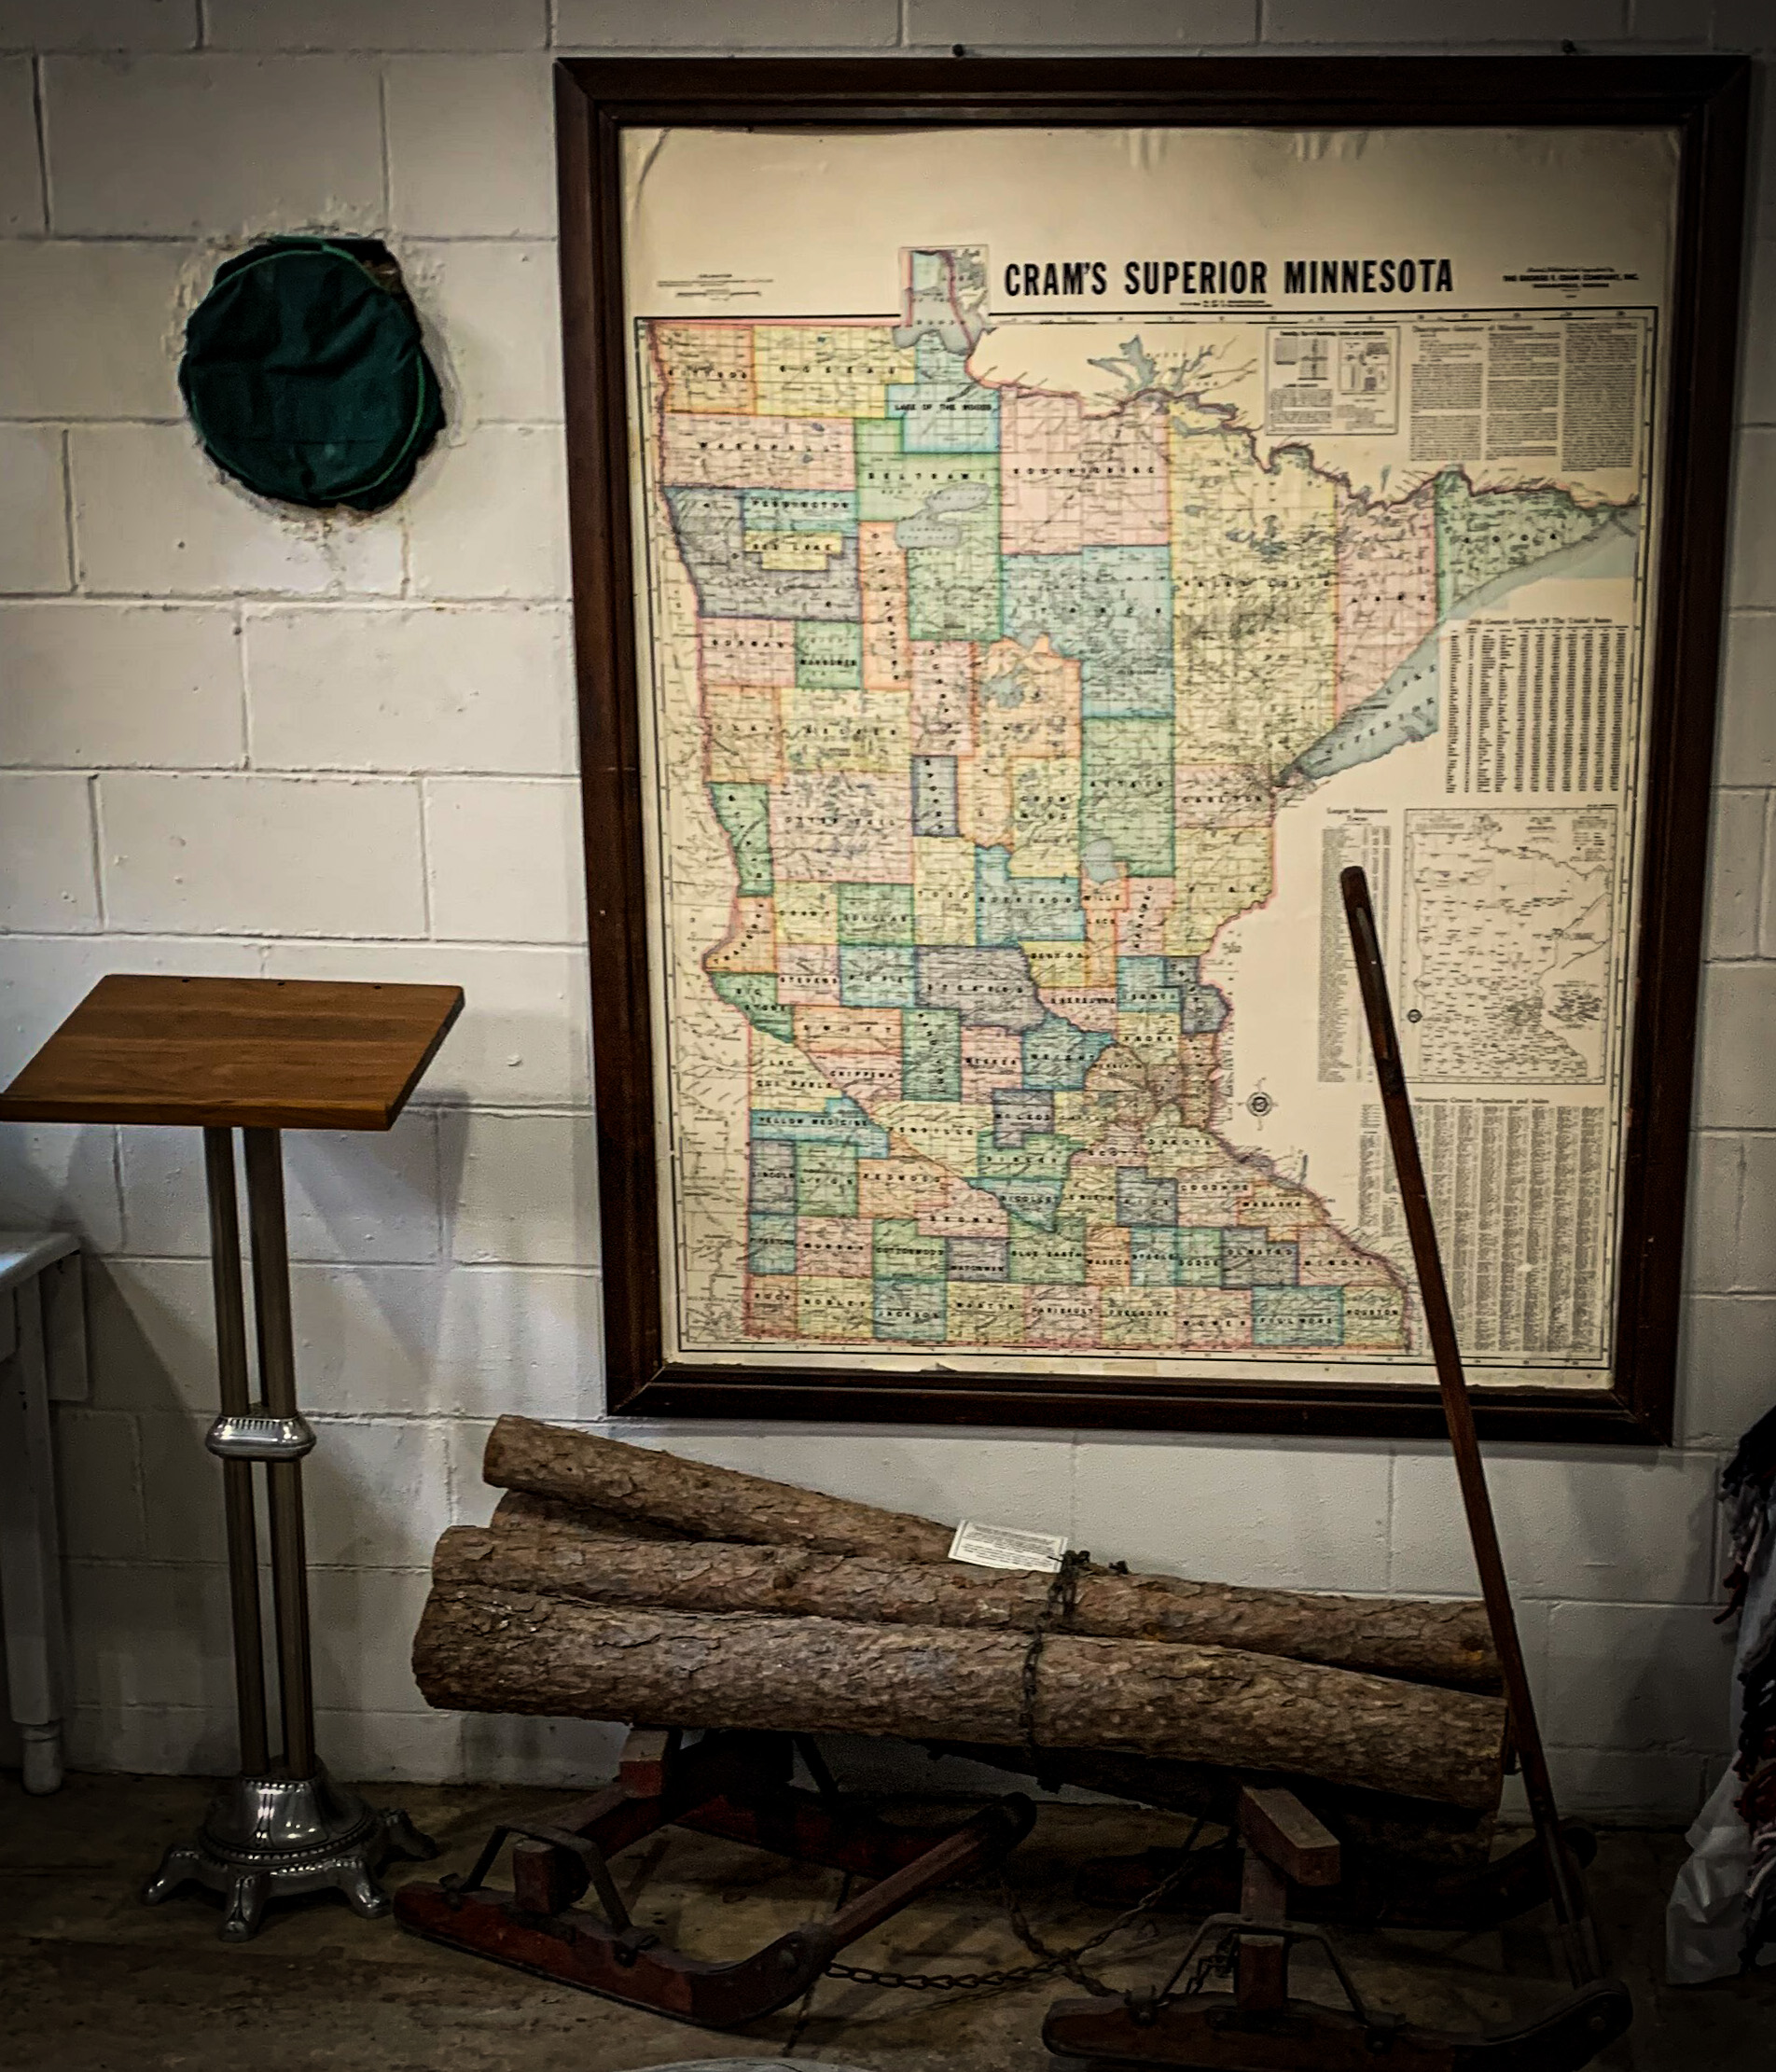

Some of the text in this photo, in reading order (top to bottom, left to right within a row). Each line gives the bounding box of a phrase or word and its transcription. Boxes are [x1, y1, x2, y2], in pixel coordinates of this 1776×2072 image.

[1006, 259, 1452, 296] CRAM'S SUPERIOR MINNESOTA
